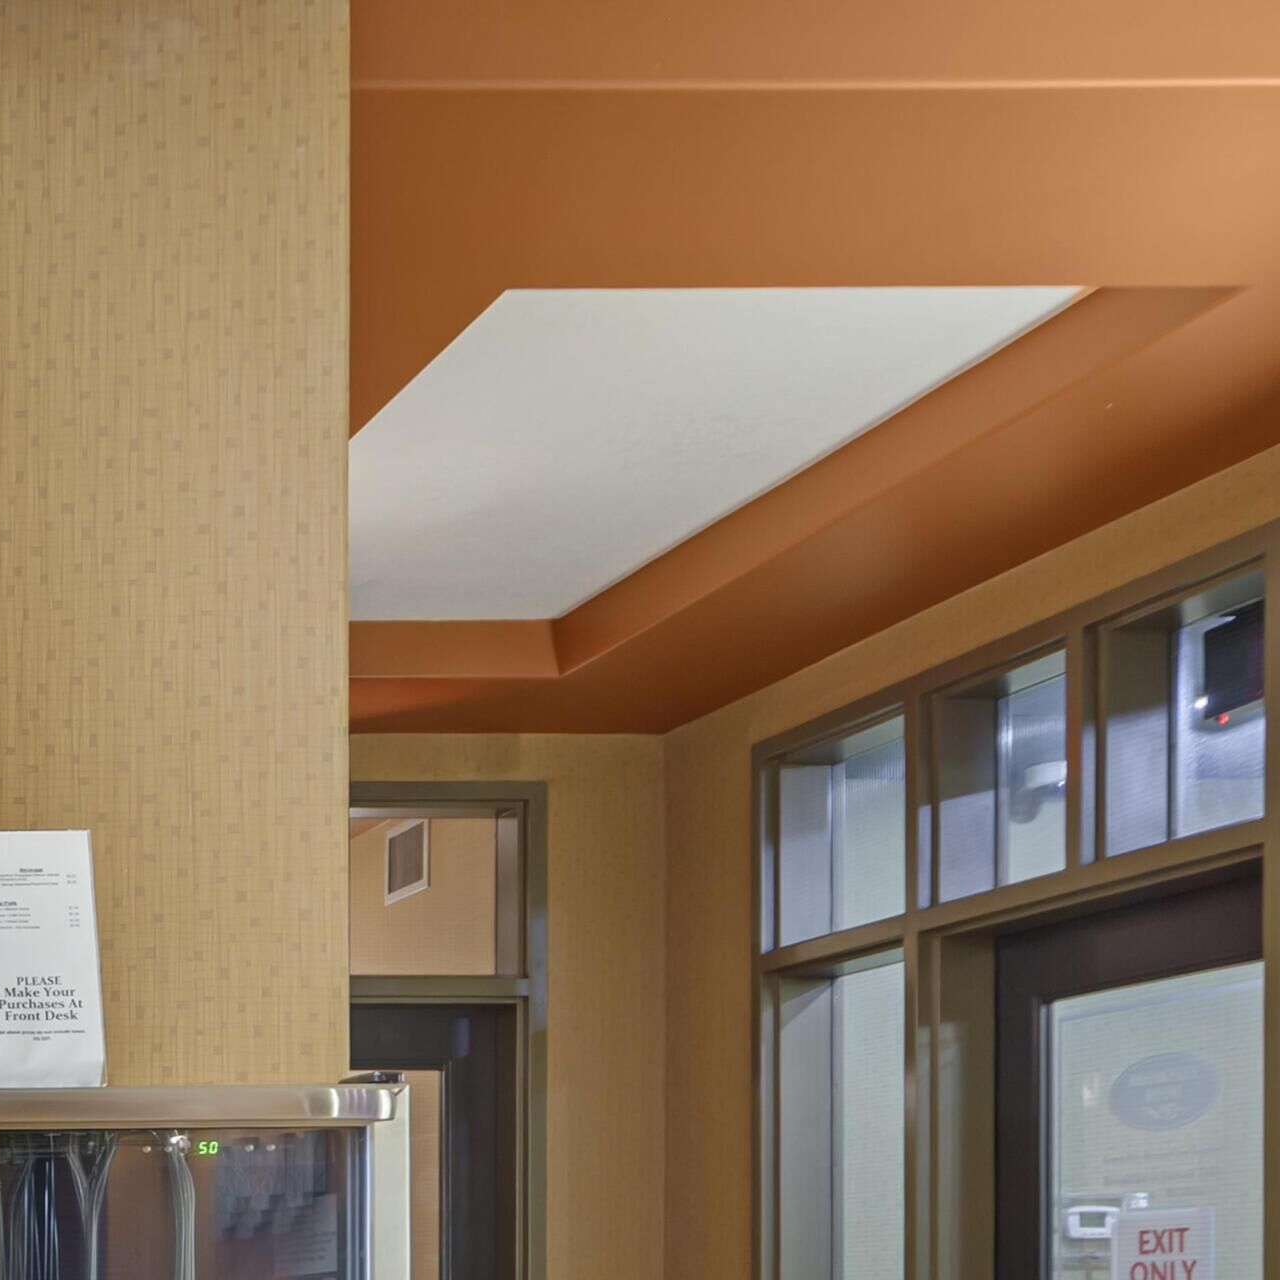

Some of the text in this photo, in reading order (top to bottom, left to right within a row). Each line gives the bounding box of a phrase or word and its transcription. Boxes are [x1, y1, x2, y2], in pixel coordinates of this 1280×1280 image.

[16, 976, 62, 986] PLEASE
[4, 987, 76, 998] Make Your
[69, 999, 83, 1009] At
[5, 1010, 79, 1021] Front Desk
[1138, 1227, 1190, 1255] EXIT
